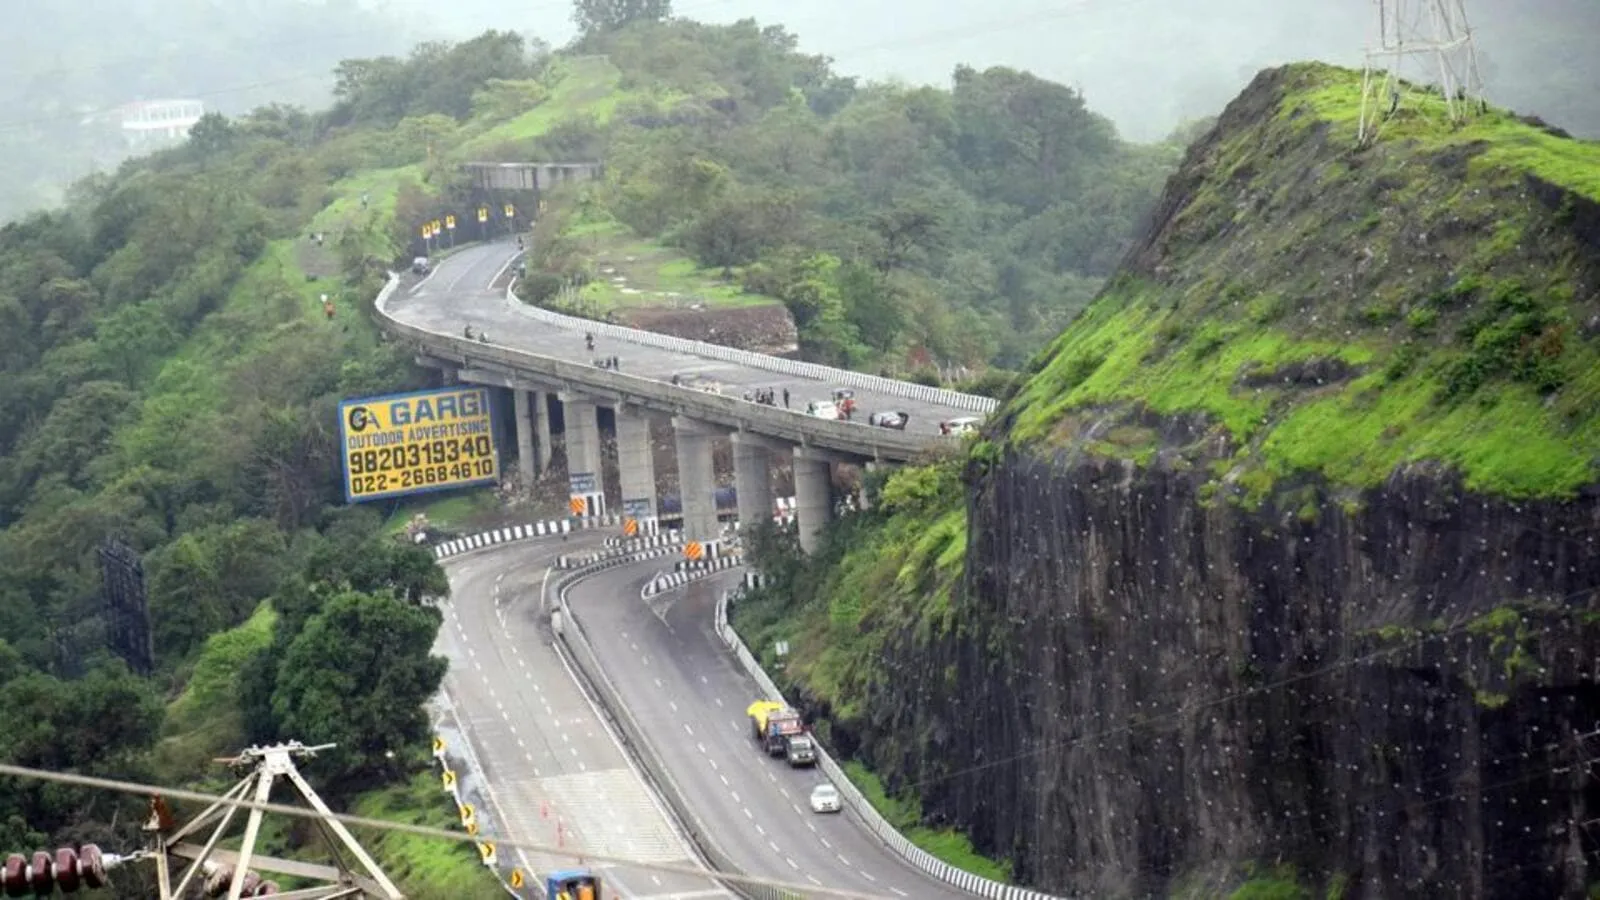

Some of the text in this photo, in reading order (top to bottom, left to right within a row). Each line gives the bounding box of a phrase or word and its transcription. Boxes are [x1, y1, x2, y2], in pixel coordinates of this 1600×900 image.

[390, 391, 488, 426] GARGI
[348, 419, 489, 450] OUTDOOR ADVERTISING
[350, 435, 491, 475] 9820319340
[352, 459, 493, 494] 022-26684610
